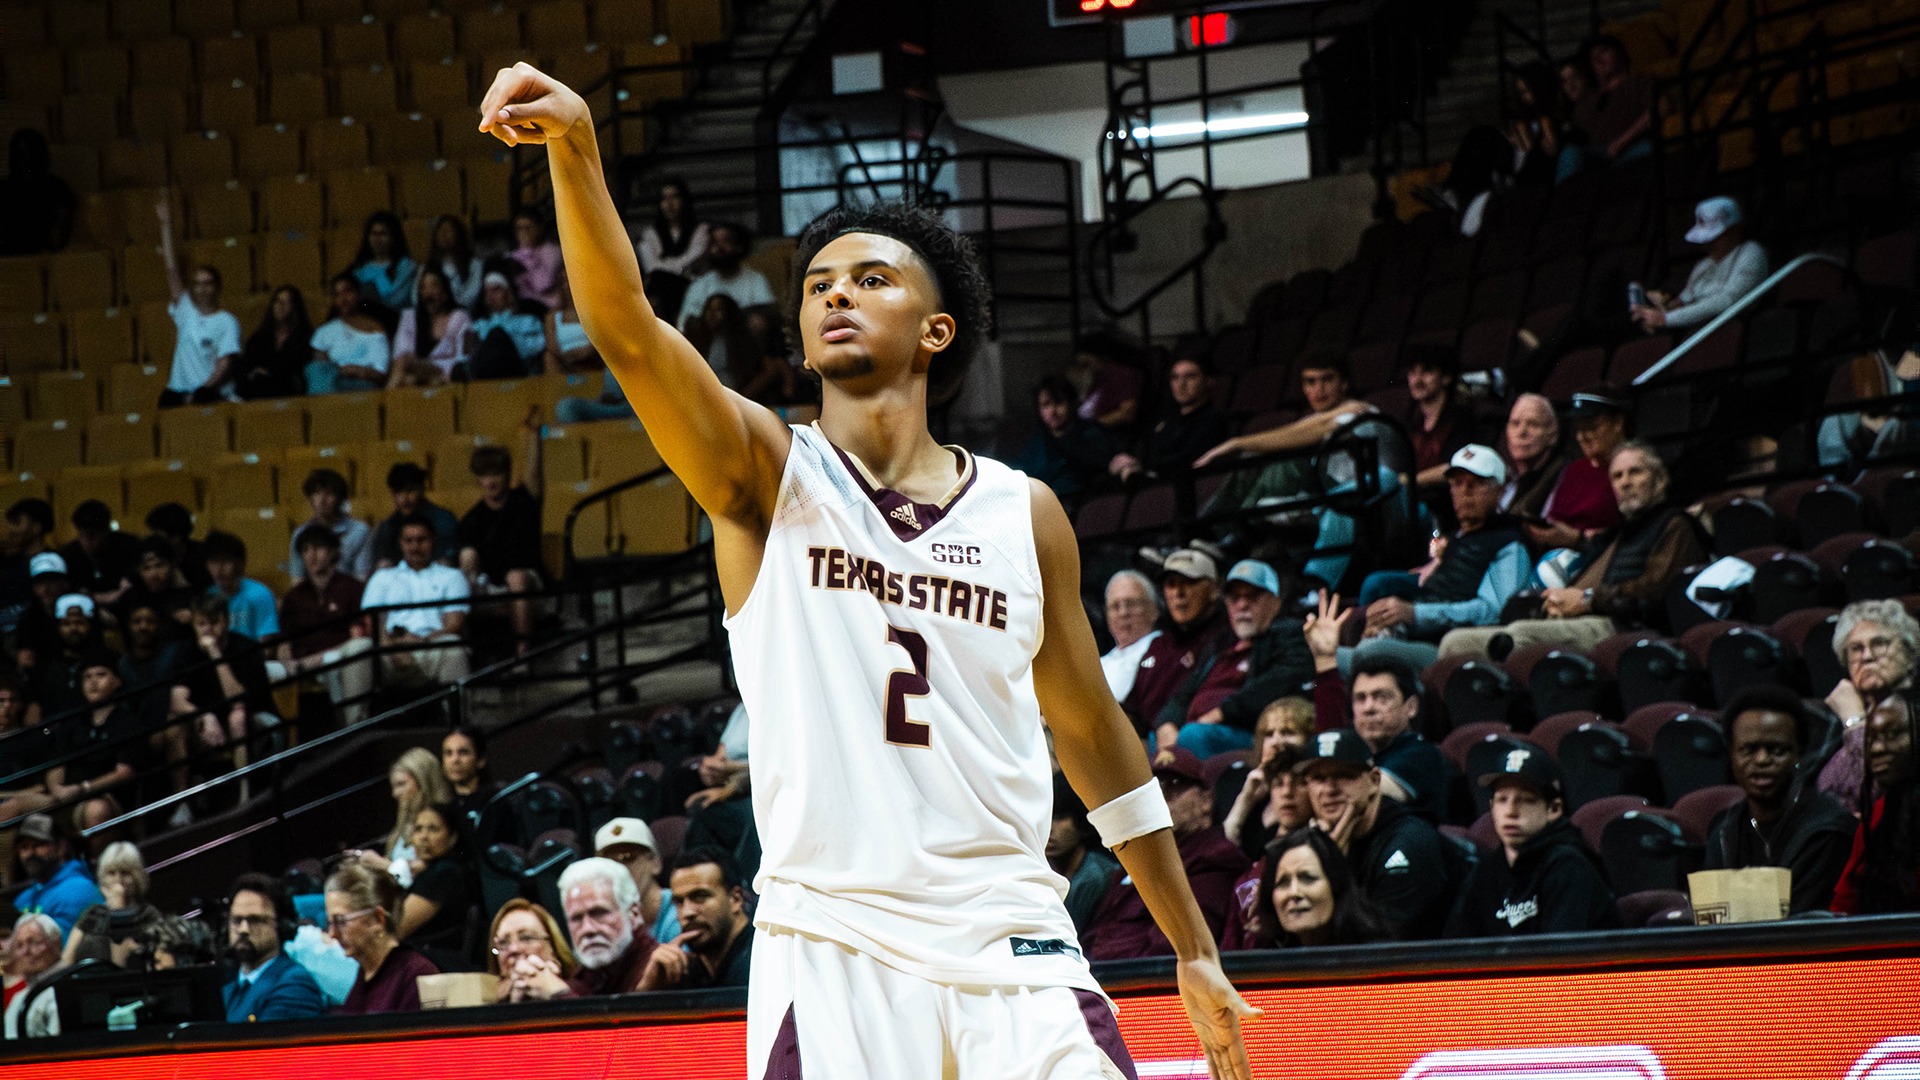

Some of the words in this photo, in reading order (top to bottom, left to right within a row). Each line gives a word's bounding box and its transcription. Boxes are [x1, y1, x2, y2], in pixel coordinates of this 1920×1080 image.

[890, 510, 922, 530] adidas
[931, 543, 982, 565] SBC
[807, 546, 904, 606] TEXAS
[908, 575, 1008, 632] STATE
[883, 622, 933, 750] 2
